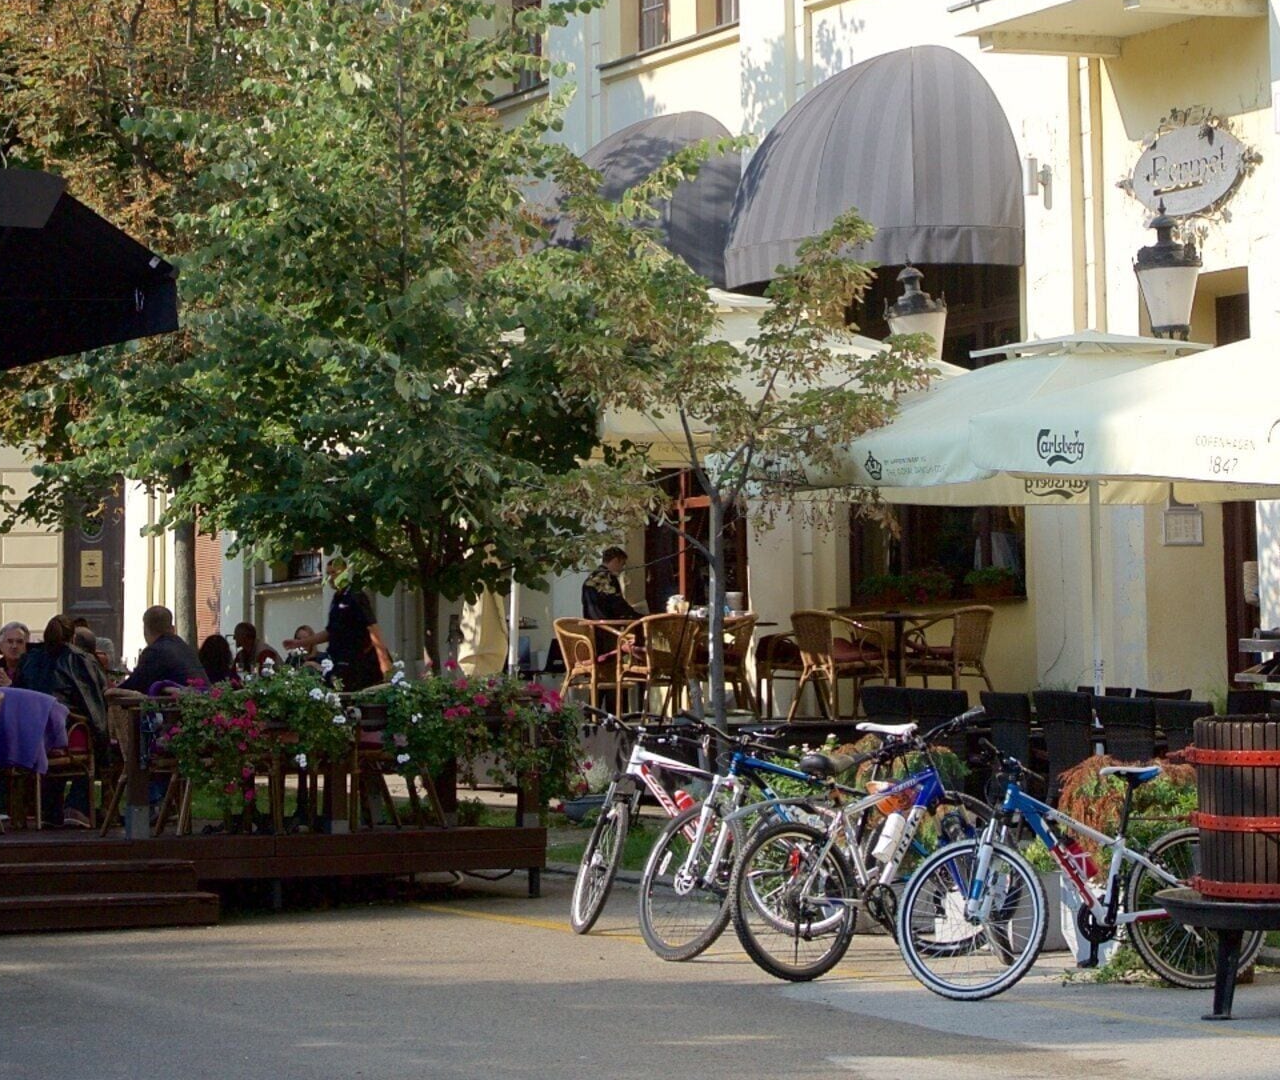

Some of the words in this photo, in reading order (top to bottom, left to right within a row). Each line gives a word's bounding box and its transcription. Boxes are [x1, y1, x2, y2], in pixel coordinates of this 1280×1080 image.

[1036, 429, 1085, 463] Carlsberg
[1195, 434, 1256, 451] COPENHAGEN
[1208, 455, 1239, 475] 1847
